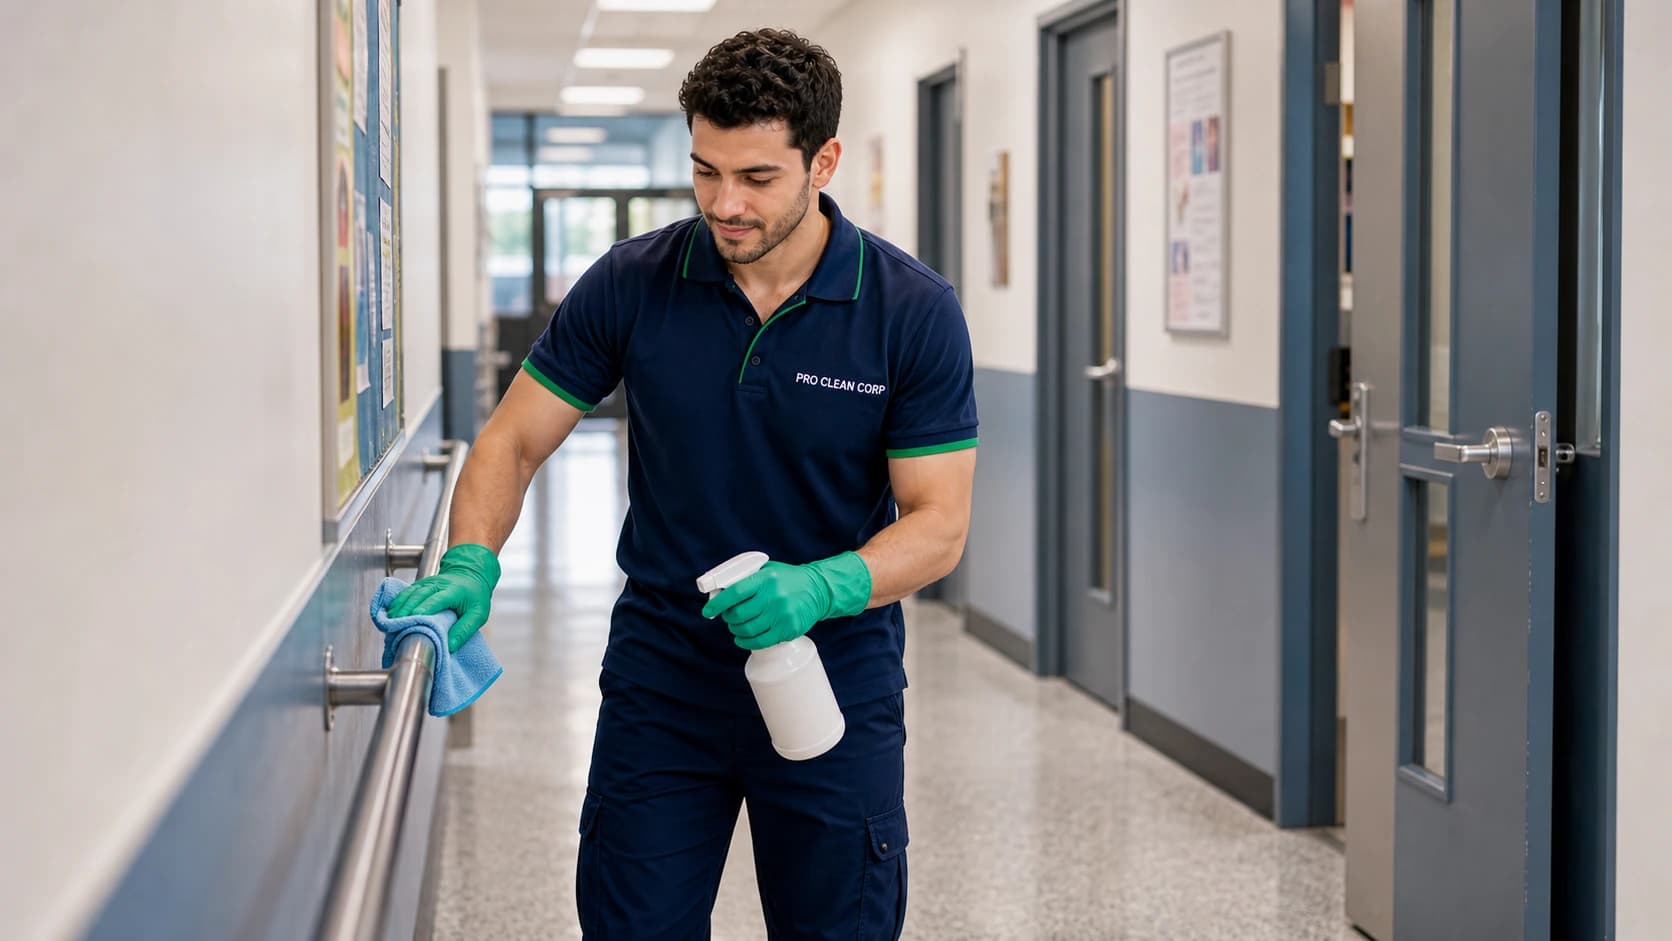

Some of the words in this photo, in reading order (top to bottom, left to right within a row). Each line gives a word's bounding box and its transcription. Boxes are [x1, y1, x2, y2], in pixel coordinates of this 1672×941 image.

[795, 372, 818, 385] PRO
[820, 377, 855, 391] CLEAN
[857, 383, 885, 395] CORP
